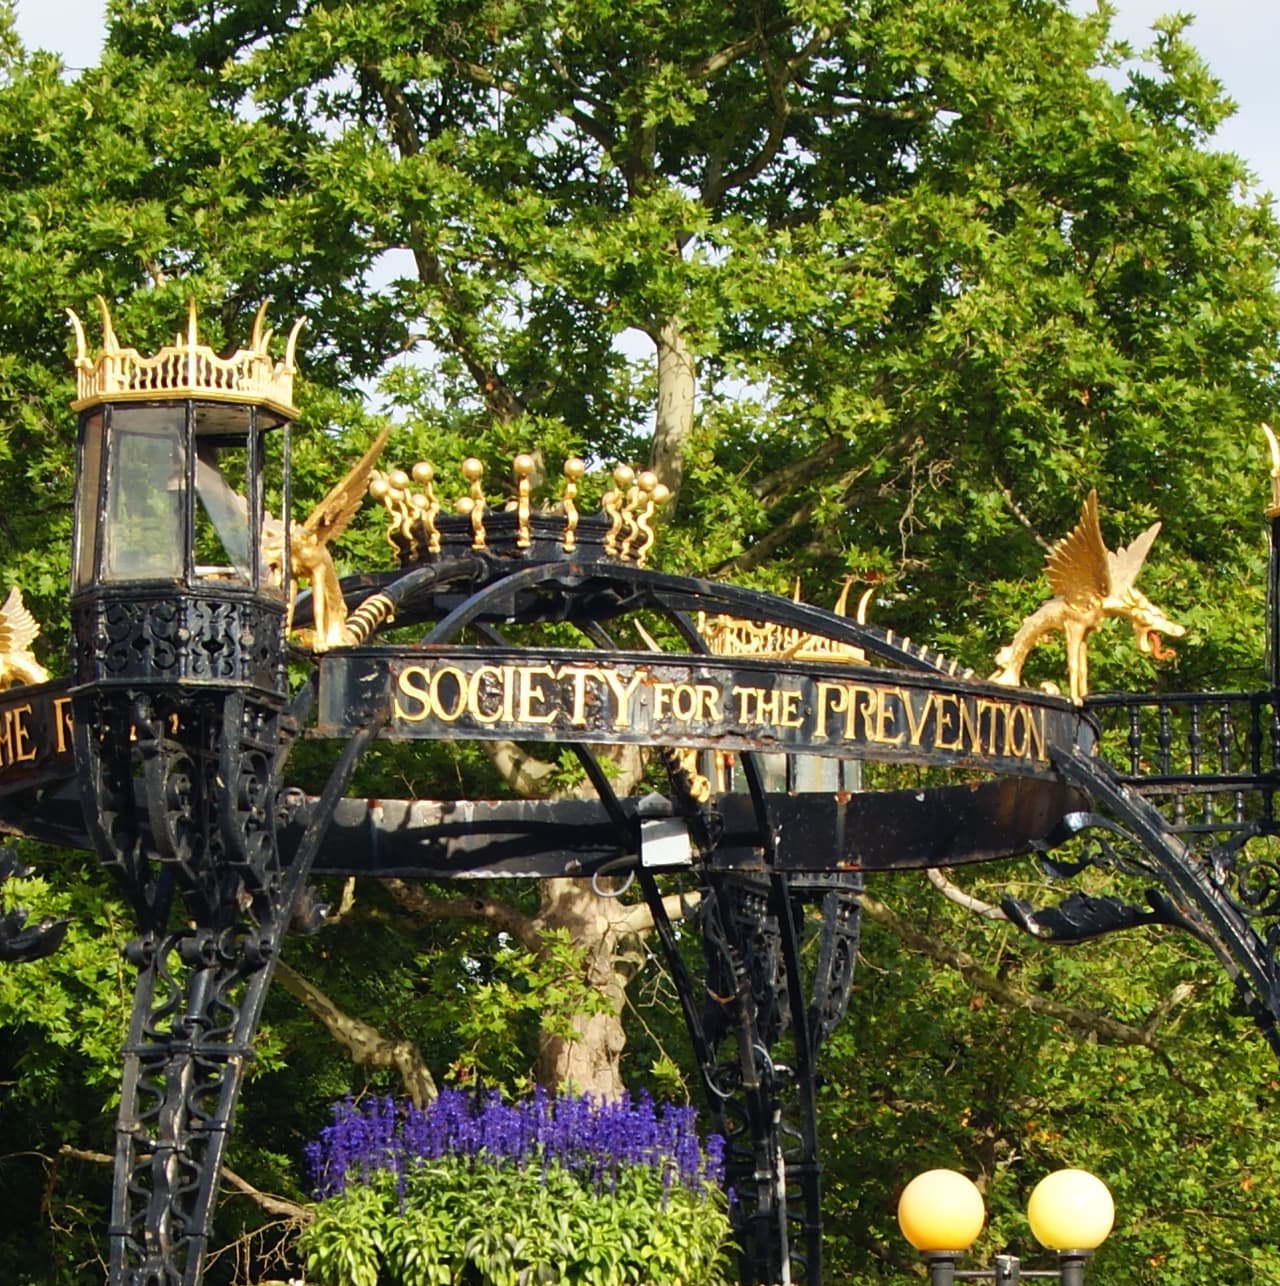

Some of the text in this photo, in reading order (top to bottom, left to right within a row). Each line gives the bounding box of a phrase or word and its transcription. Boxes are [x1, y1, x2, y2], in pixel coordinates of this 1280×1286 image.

[393, 664, 1047, 762] SOCIETY FOR THE PREVENTION
